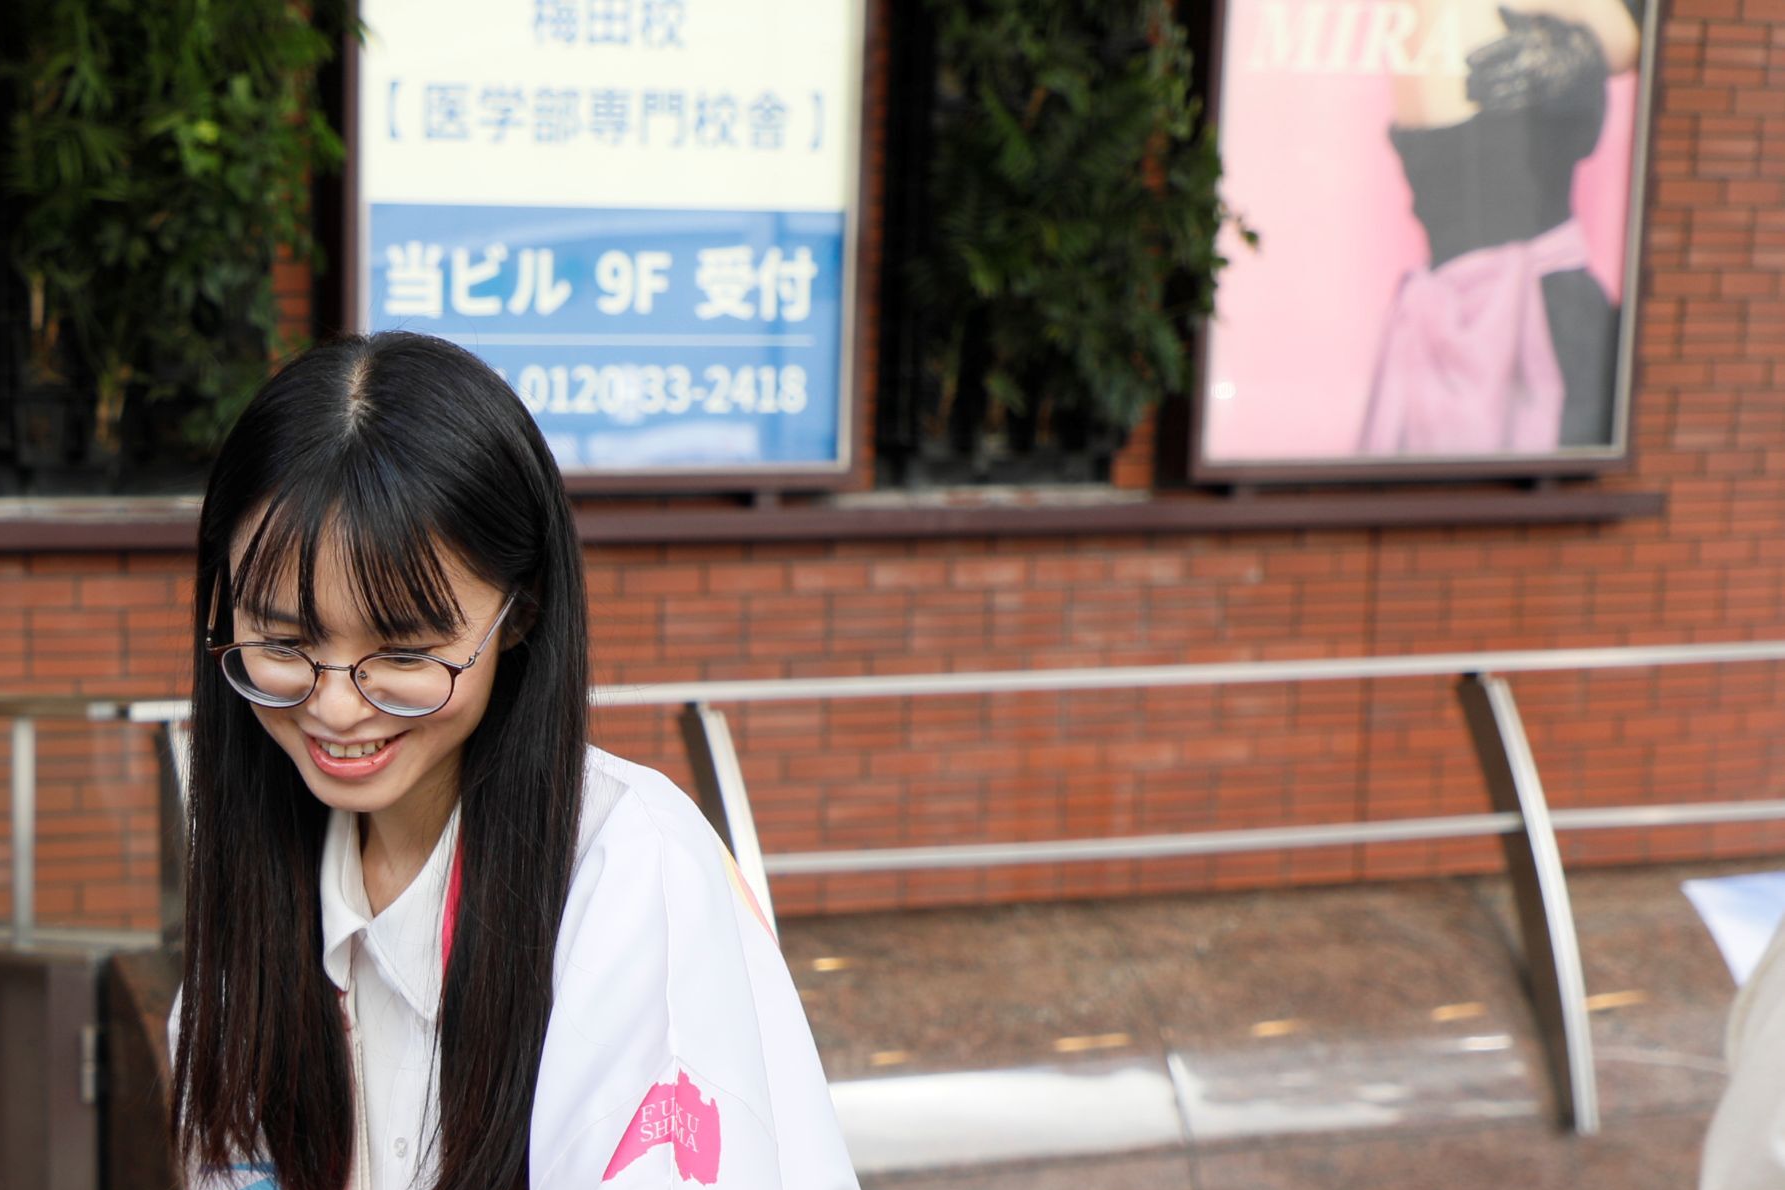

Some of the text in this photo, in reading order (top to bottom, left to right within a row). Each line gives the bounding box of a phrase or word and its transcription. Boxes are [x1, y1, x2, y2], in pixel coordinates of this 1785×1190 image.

[383, 240, 819, 321] 当ビル 9F 受付
